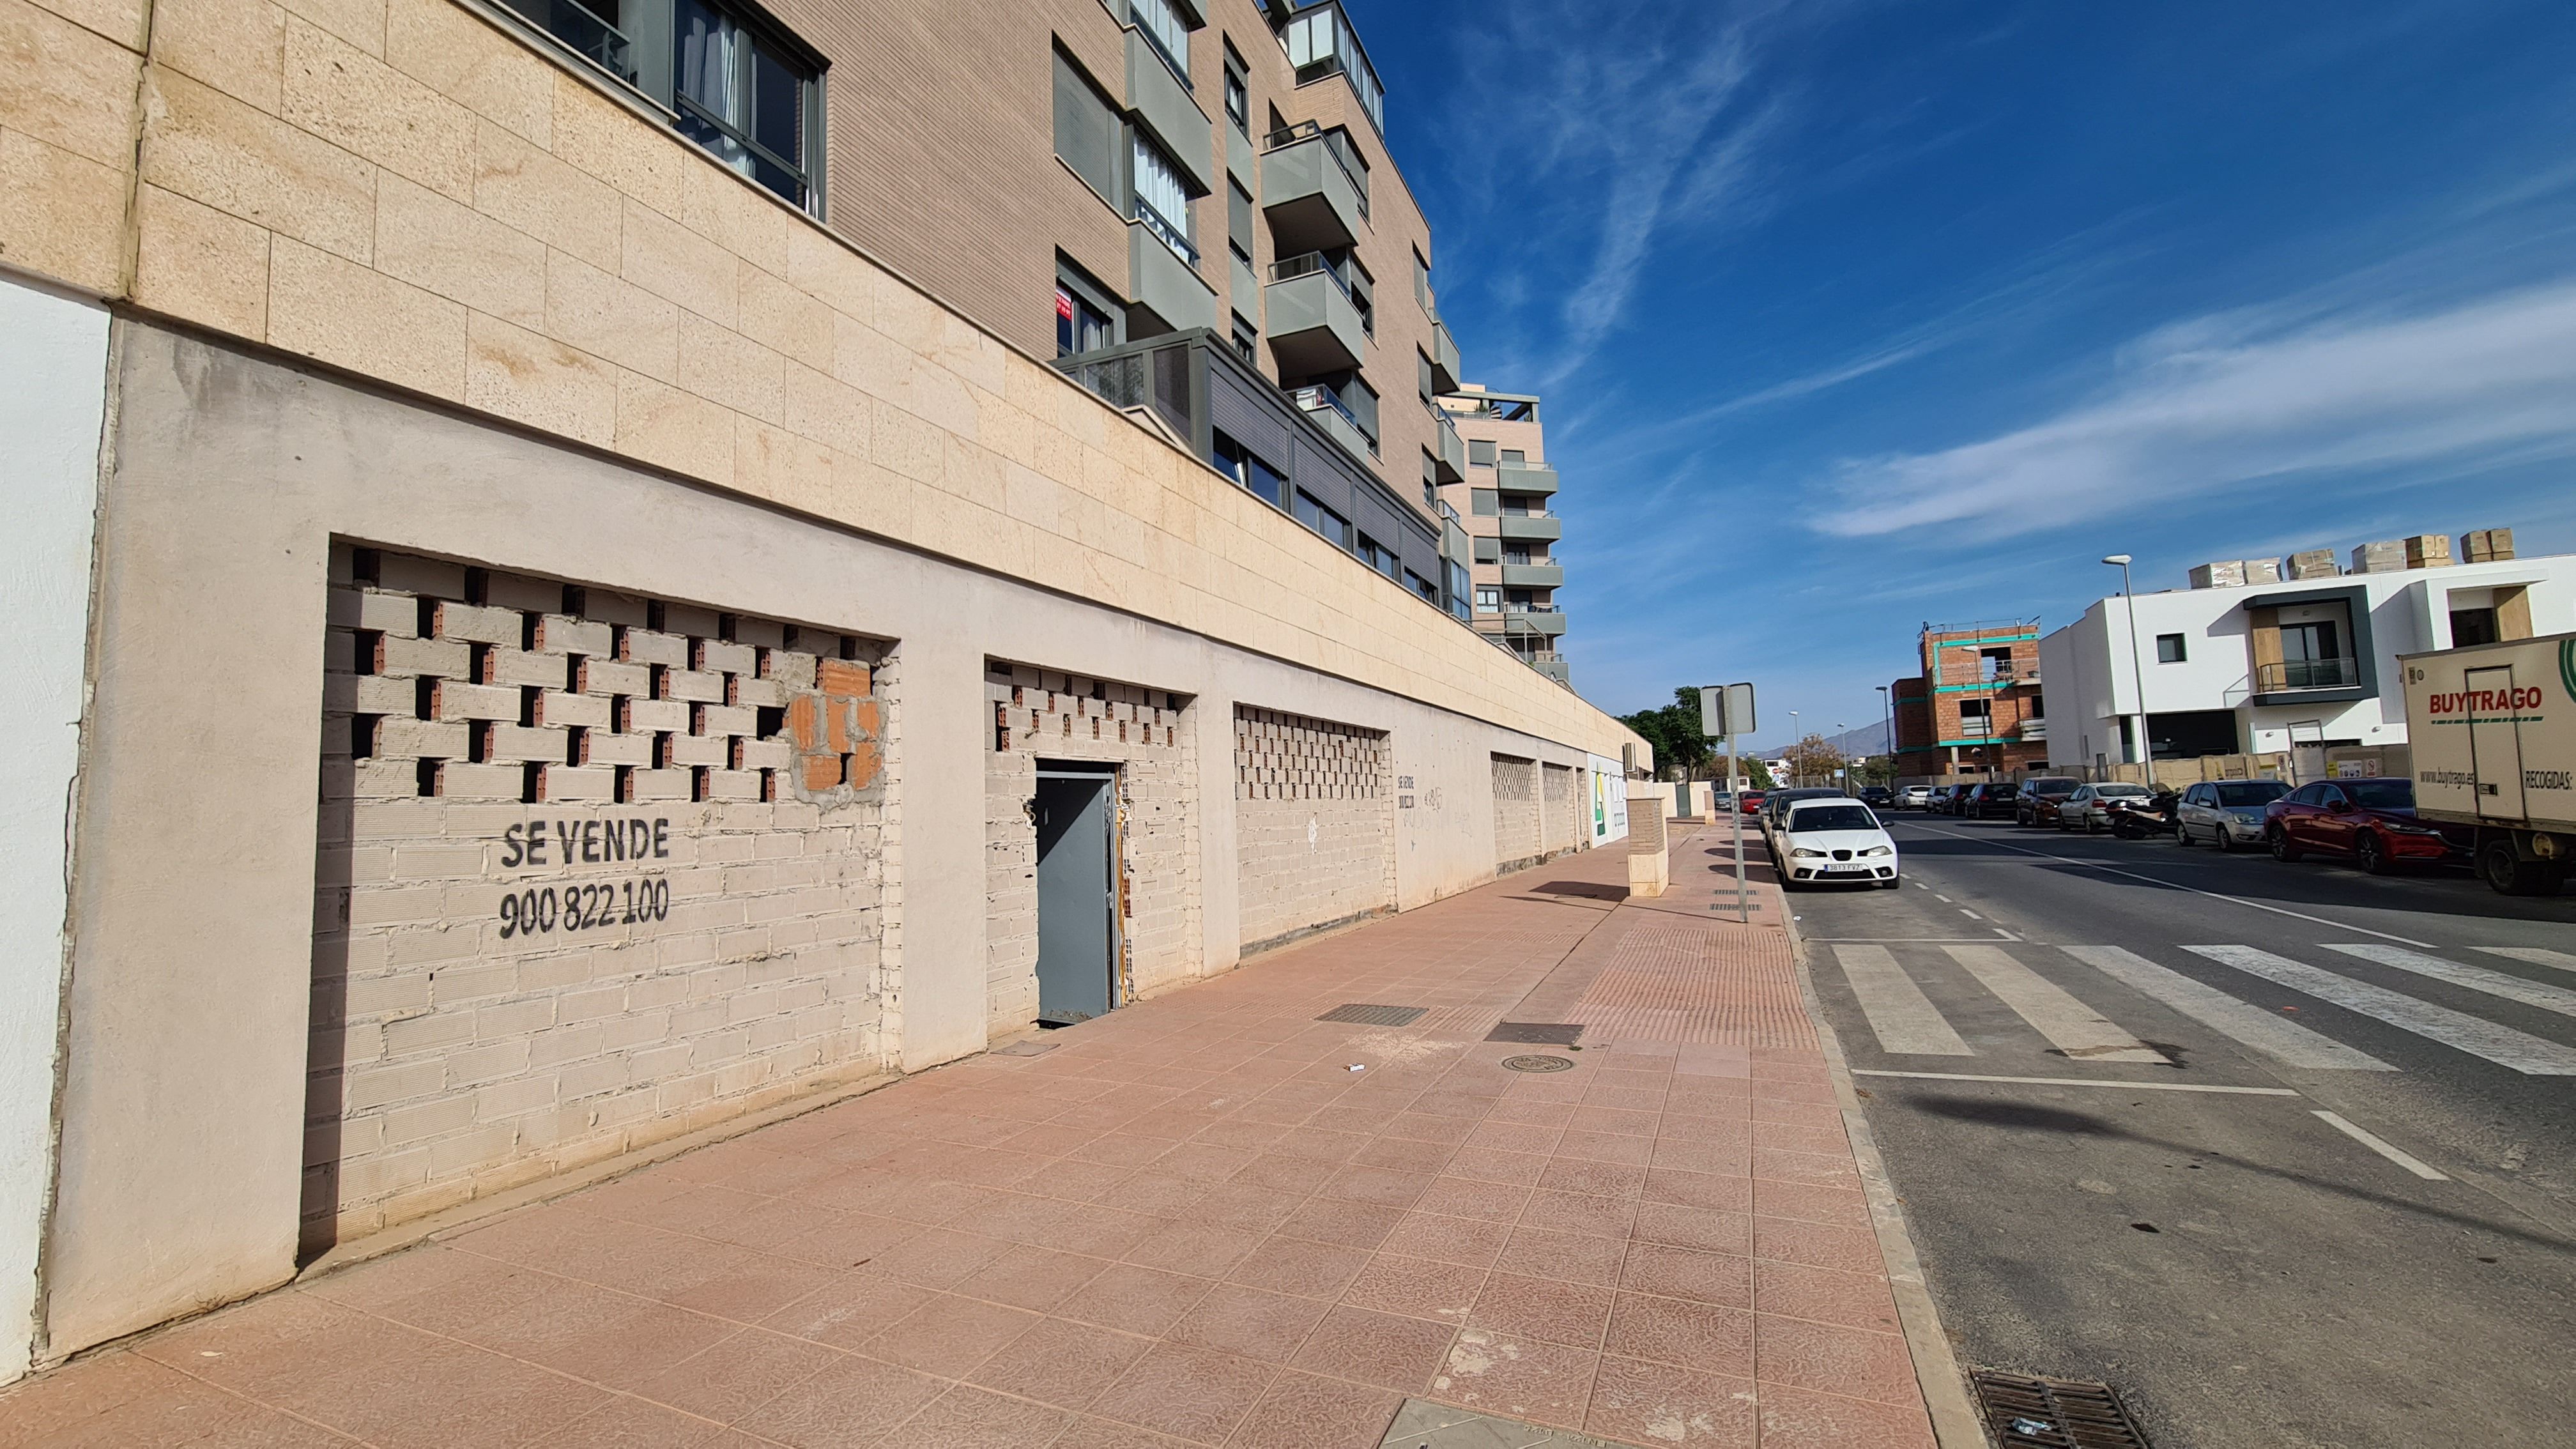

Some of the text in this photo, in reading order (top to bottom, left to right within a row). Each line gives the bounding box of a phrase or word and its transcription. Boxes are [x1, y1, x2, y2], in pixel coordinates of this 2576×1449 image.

[2430, 686, 2542, 714] BUYTRAGO
[2420, 767, 2474, 790] www.buytrago.es
[2526, 770, 2573, 790] RECOGIDAS:
[501, 818, 668, 867] SE VENDE
[500, 878, 669, 939] 900 822 100
